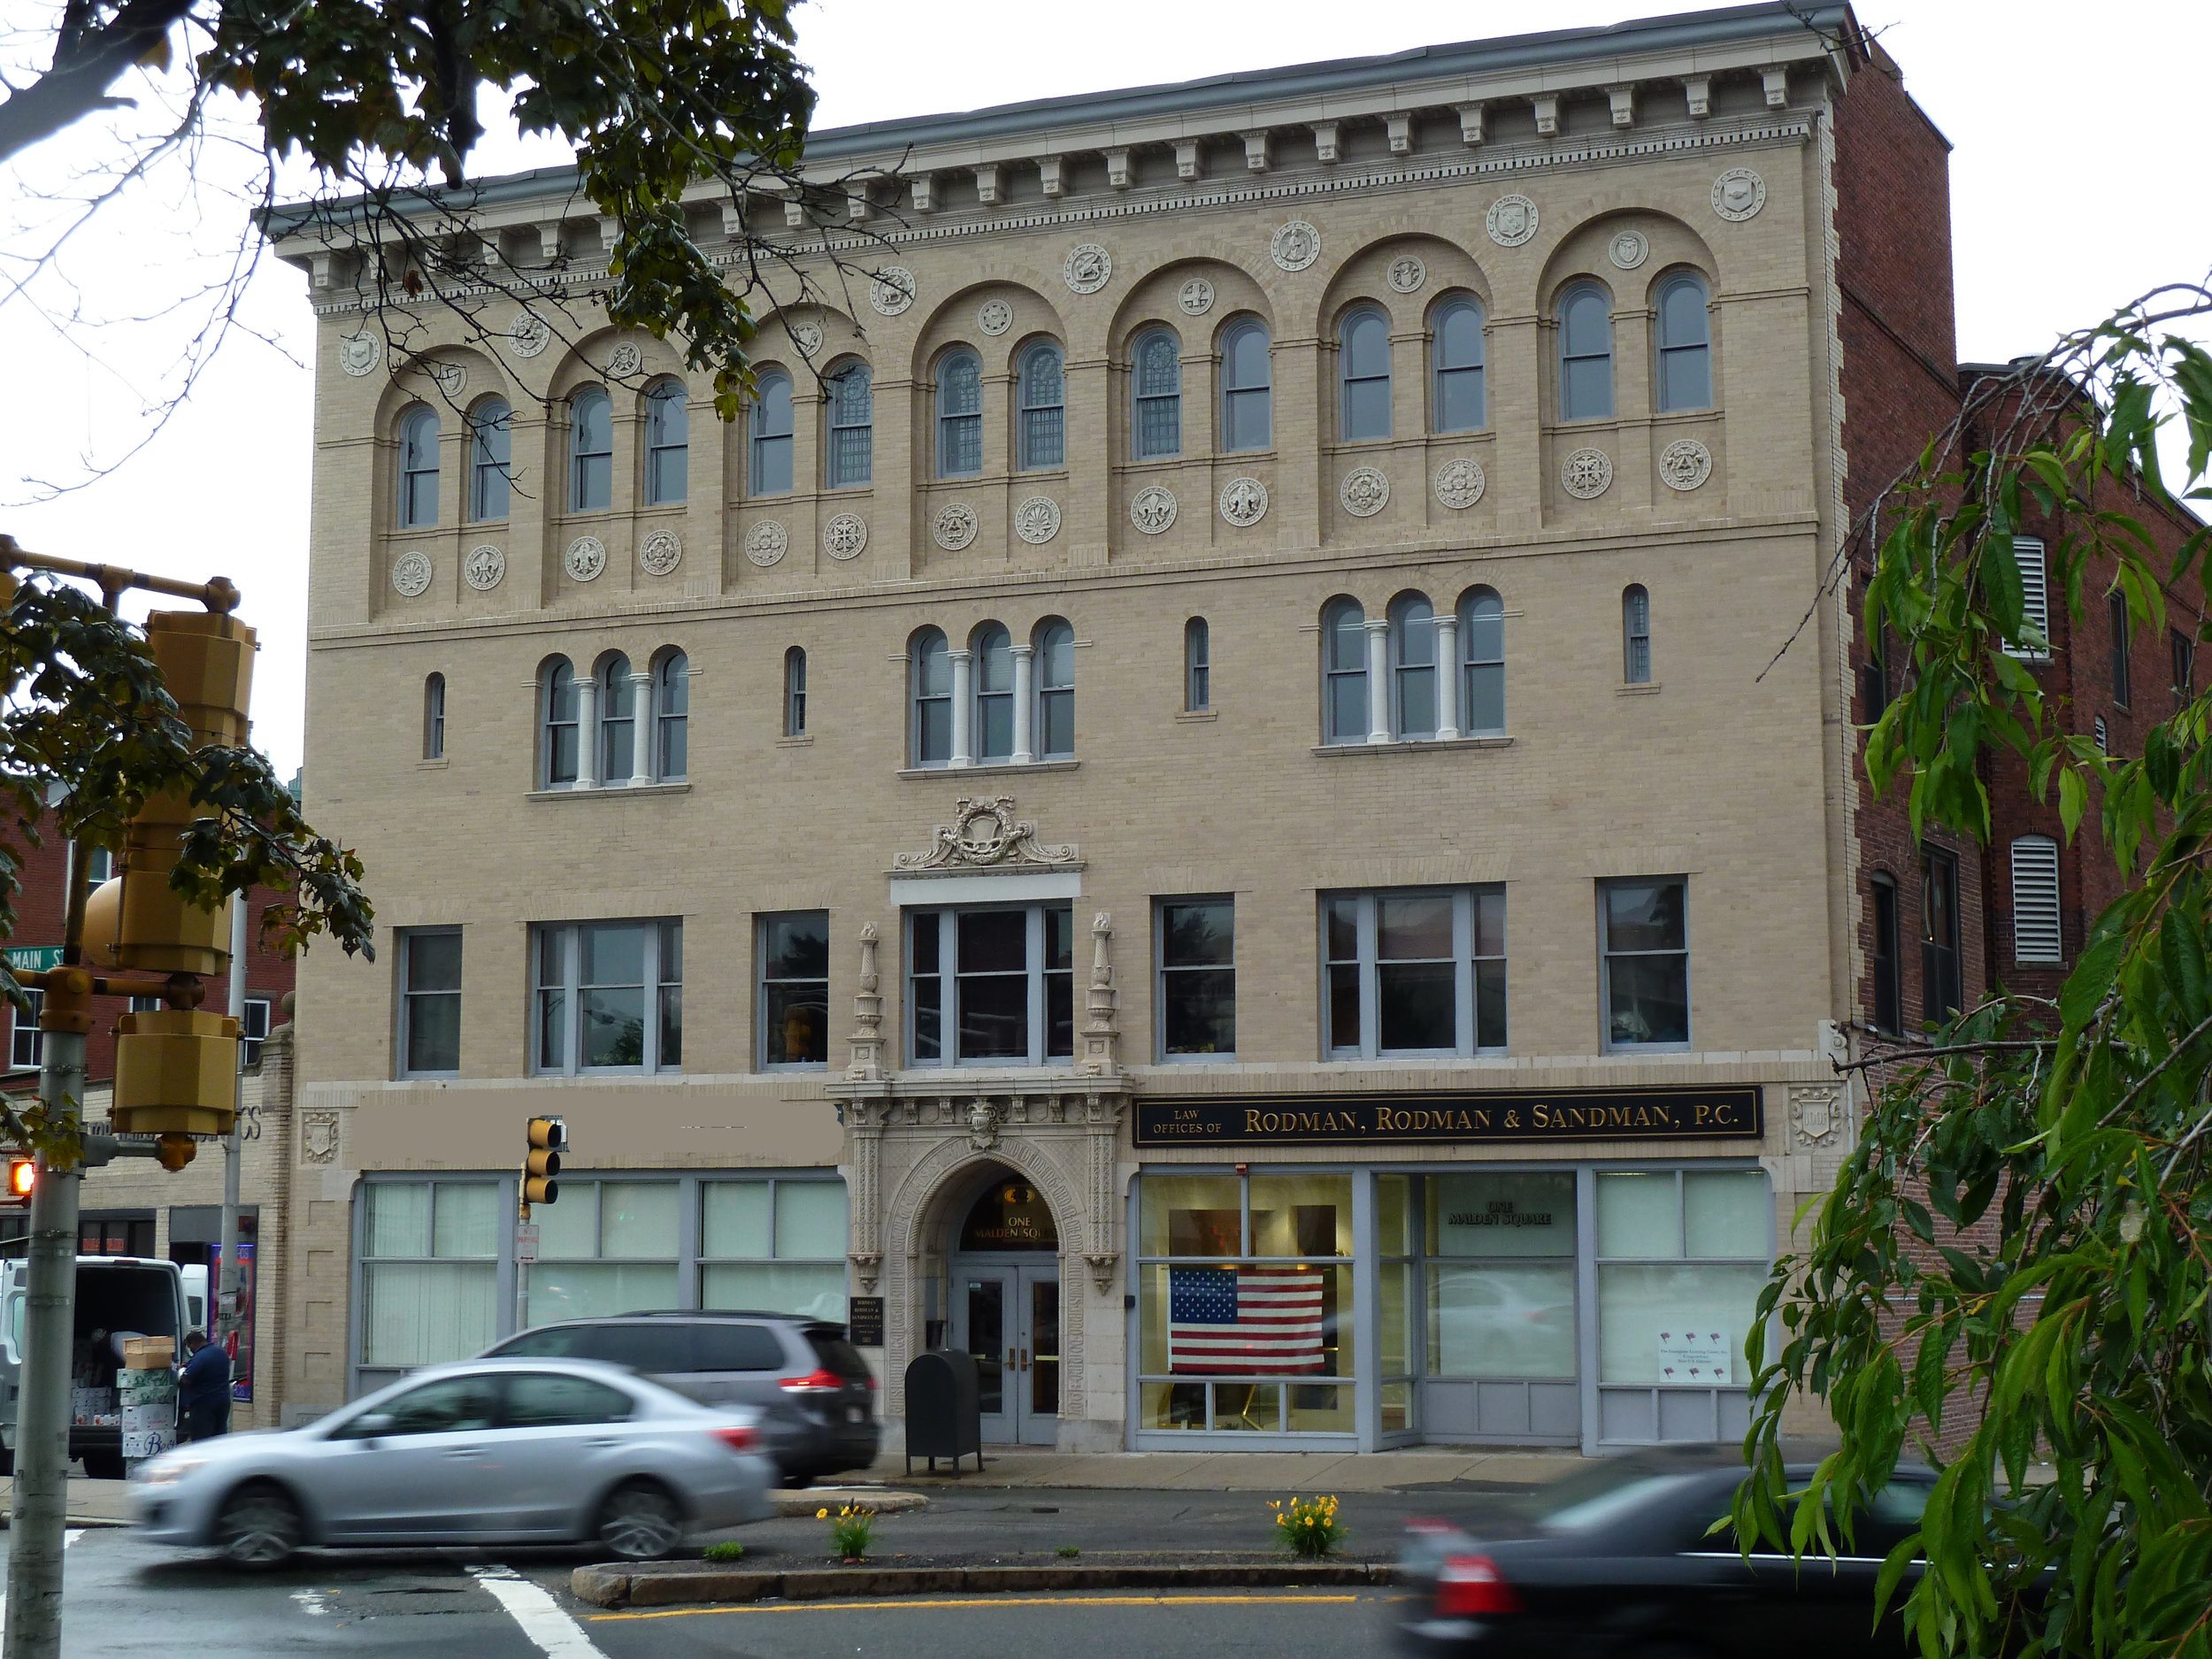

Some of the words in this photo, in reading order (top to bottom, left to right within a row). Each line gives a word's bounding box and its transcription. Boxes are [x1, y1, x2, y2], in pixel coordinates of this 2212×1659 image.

[12, 949, 42, 969] MAIN
[1174, 1110, 1199, 1120] LAW
[1243, 1109, 1366, 1133] RODMAN,
[1375, 1106, 1493, 1131] RODMAN
[1504, 1109, 1521, 1128] &
[1532, 1103, 1680, 1129] SANDMAN,
[1694, 1104, 1739, 1125] P.C.
[1153, 1123, 1202, 1133] OFFICES
[1206, 1123, 1222, 1133] OF
[1488, 1202, 1513, 1213] ONE
[1008, 1217, 1032, 1227] ONE
[1448, 1213, 1499, 1225] MALDEN
[1502, 1213, 1552, 1227] SQUARE
[976, 1228, 1018, 1238] MALDEN
